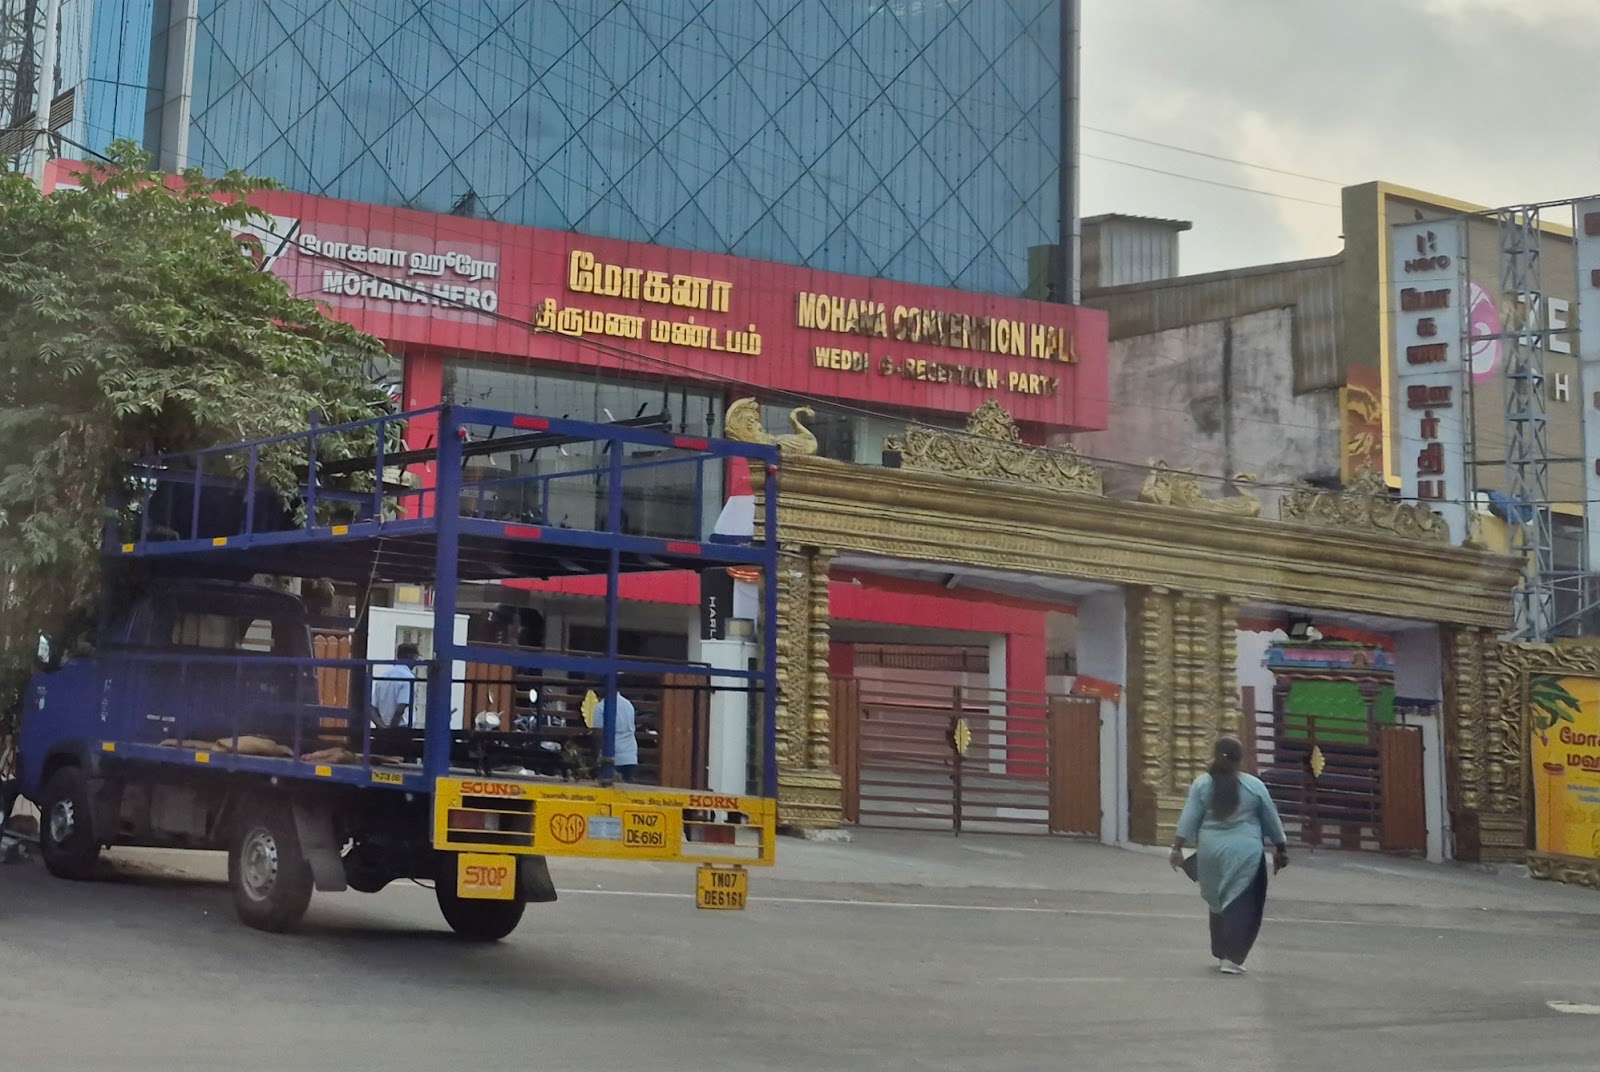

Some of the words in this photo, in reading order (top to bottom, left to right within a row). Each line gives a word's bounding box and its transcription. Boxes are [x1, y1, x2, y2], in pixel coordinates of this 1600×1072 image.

[299, 233, 407, 267] மோகனா
[322, 269, 428, 304] MOHANA
[431, 284, 498, 312] HERO
[568, 249, 733, 312] மோகனா
[535, 297, 646, 339] திருமண
[650, 315, 762, 355] மண்டபம்
[797, 291, 888, 338] MOHANA
[688, 795, 739, 809] HORN
[463, 866, 507, 886] STOP
[711, 872, 737, 888] TN07
